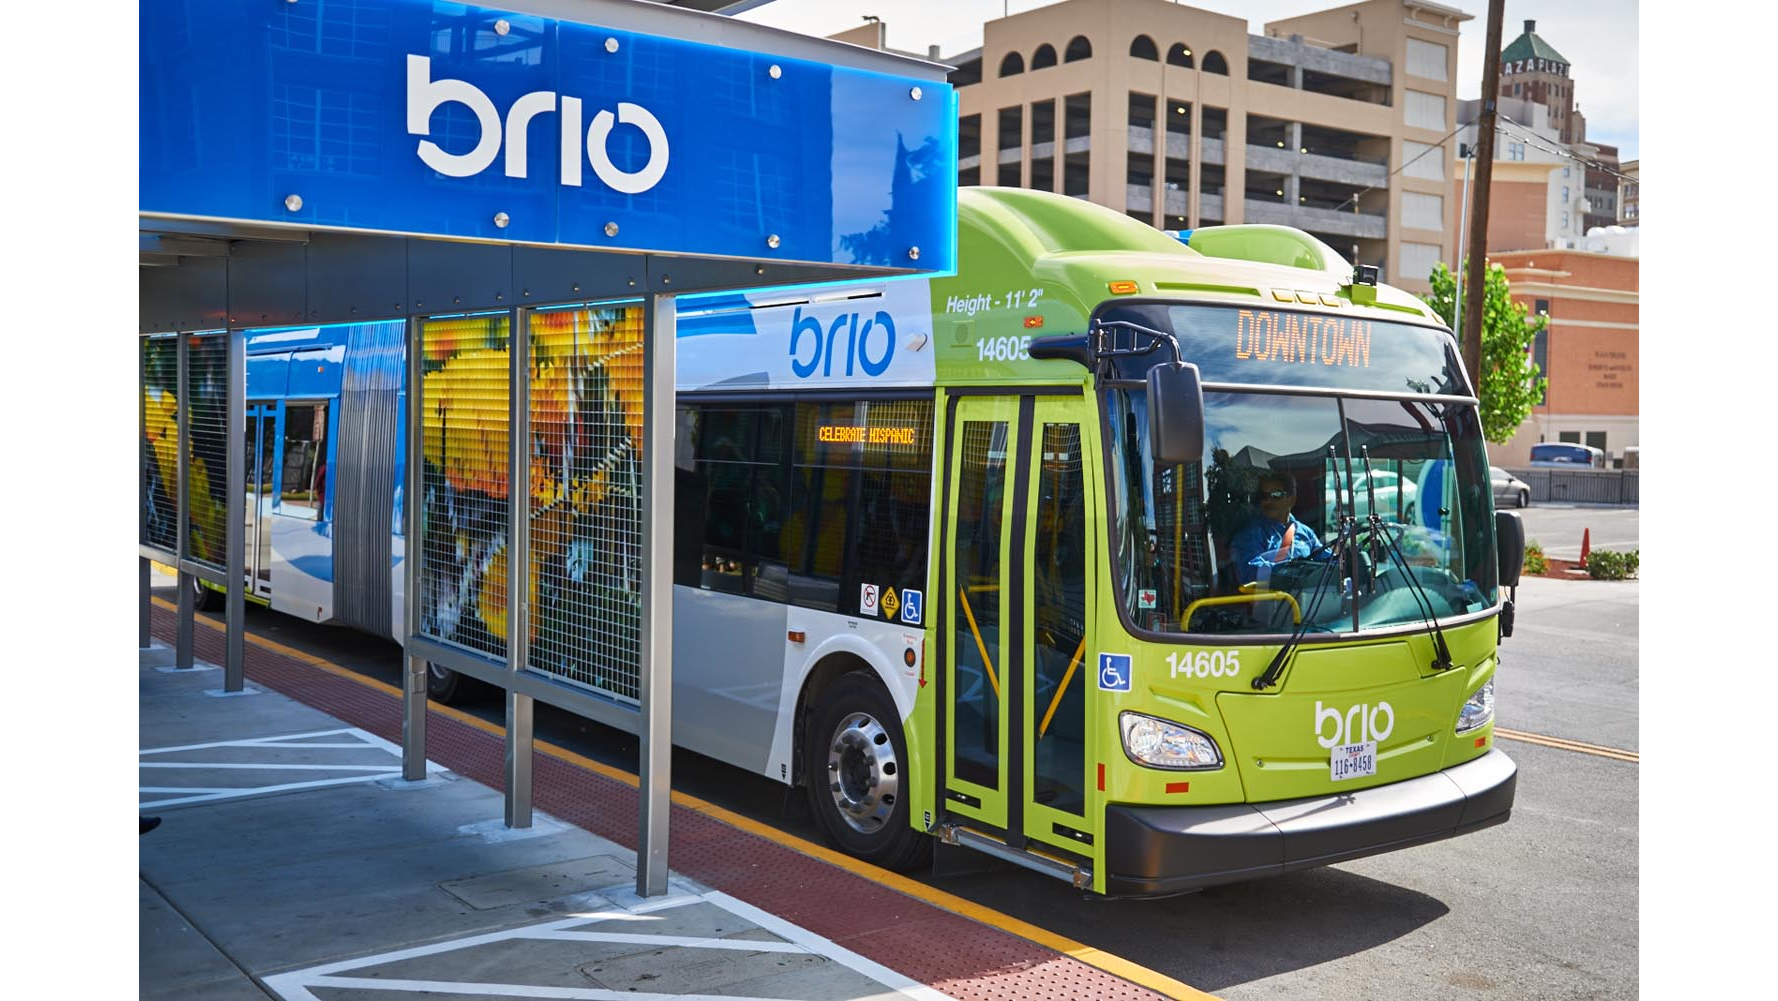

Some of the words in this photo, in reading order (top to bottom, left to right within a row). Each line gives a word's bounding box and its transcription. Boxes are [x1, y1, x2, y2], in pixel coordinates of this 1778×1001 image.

[407, 54, 669, 194] brio
[946, 293, 992, 316] Height
[1005, 290, 1026, 309] 11'
[789, 306, 896, 378] brio
[976, 335, 1032, 361] 14605
[1236, 309, 1372, 369] DOWNTOWN
[819, 426, 866, 442] CELEBRATE
[869, 427, 915, 444] HISPANIC
[1165, 650, 1240, 679] 14605
[1315, 701, 1395, 749] brio
[1345, 744, 1364, 754] TEXAS
